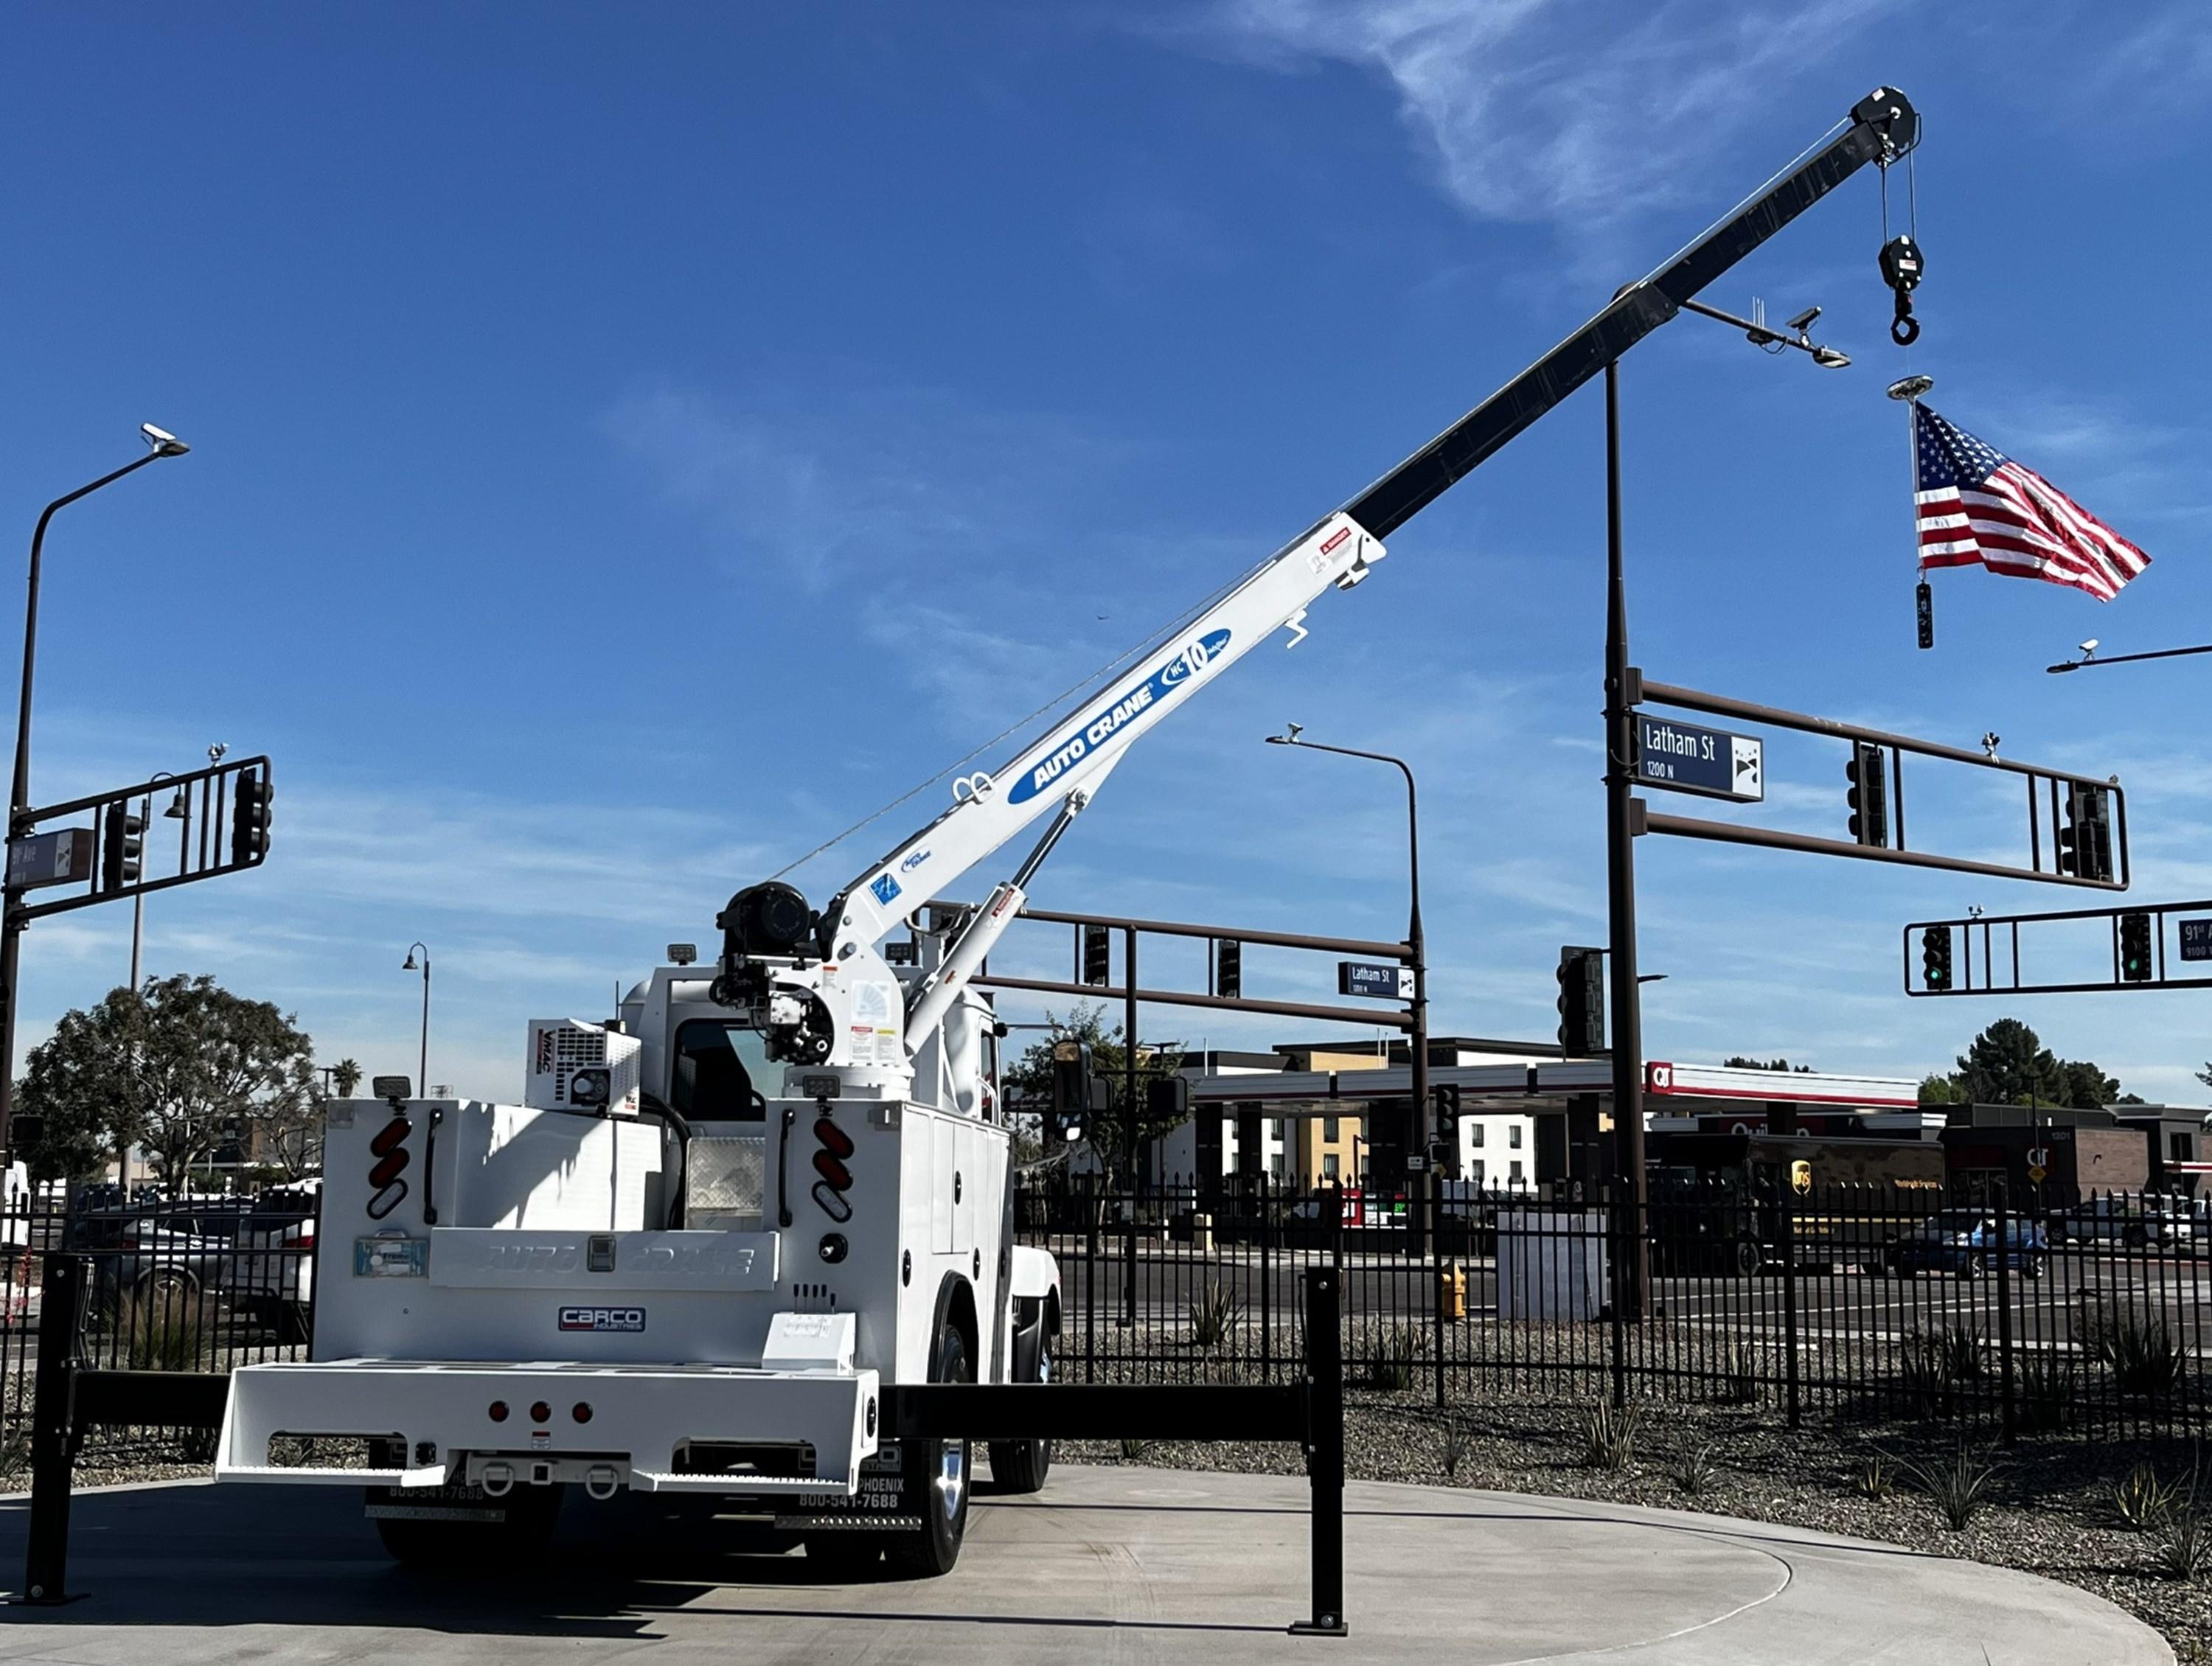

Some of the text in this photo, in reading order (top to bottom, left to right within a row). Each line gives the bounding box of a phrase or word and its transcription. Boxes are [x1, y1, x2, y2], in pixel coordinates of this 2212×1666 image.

[1034, 738, 1085, 790] AUTO
[1087, 685, 1152, 745] CRANE
[1170, 661, 1184, 677] HC
[1180, 641, 1208, 677] 10
[1646, 724, 1715, 761] Latham St
[1647, 761, 1674, 778] 1200 N
[2185, 946, 2207, 957] 9100
[1352, 966, 1390, 983] Latham St
[542, 1030, 556, 1073] VMAC
[1653, 1067, 1671, 1087] QT
[2051, 1132, 2070, 1140] 1201
[799, 1493, 898, 1508] 800-541-7688
